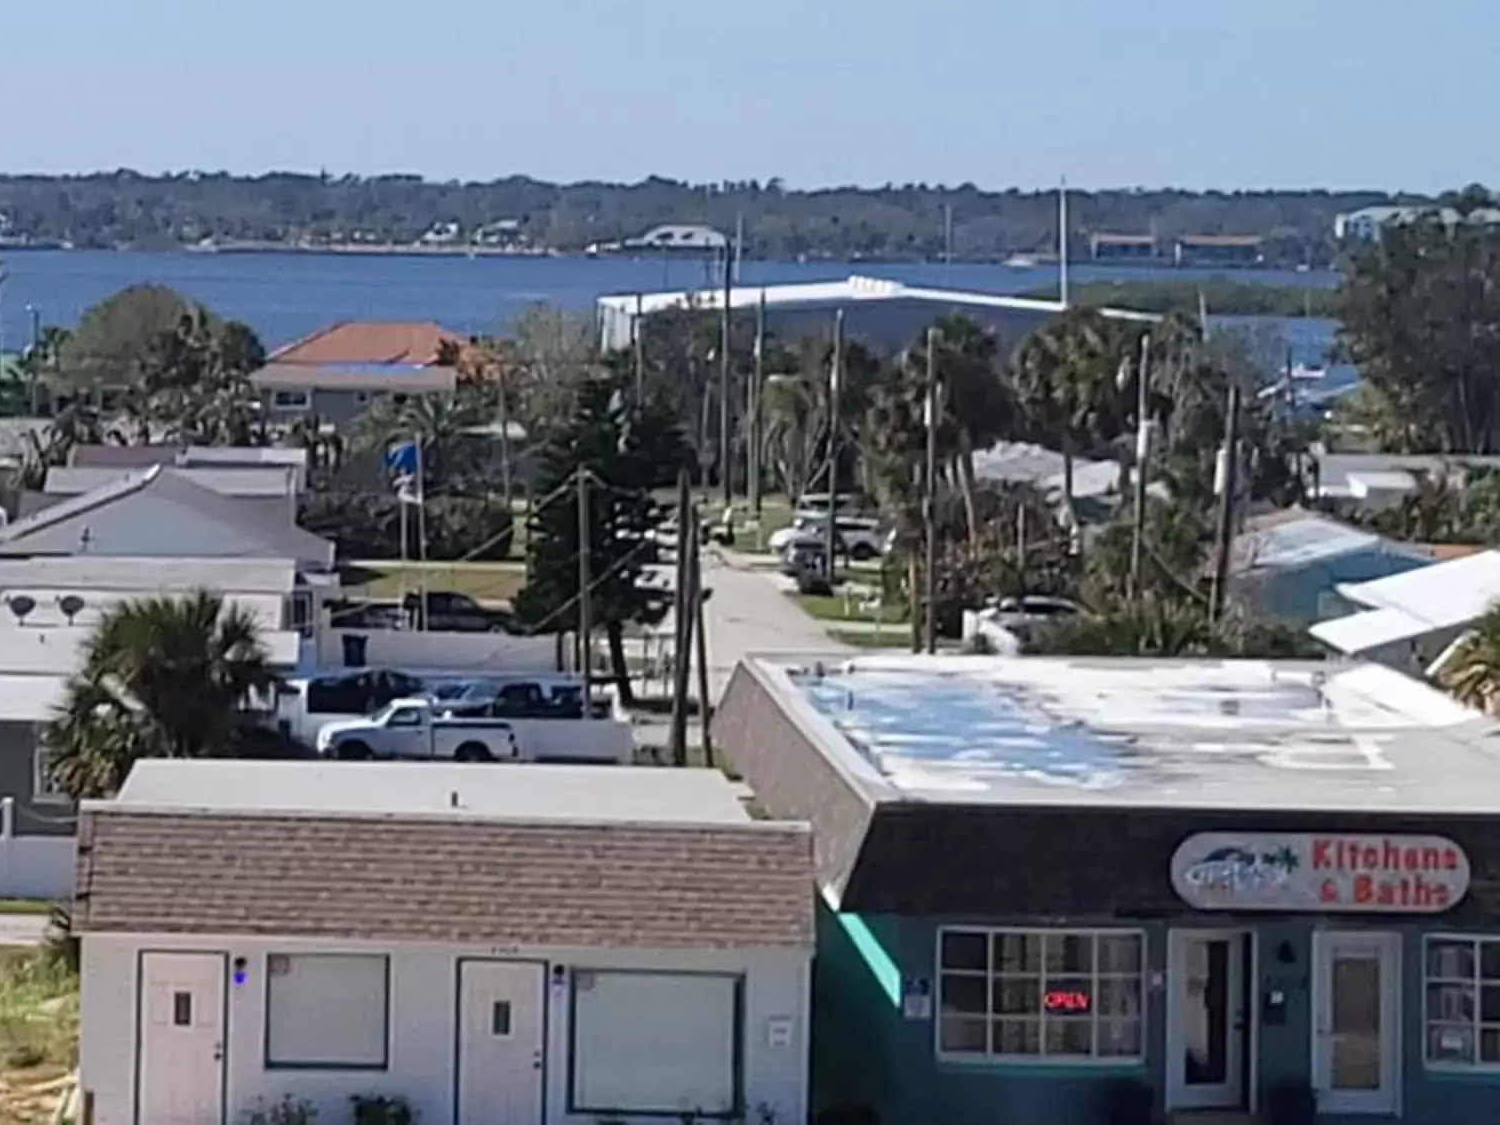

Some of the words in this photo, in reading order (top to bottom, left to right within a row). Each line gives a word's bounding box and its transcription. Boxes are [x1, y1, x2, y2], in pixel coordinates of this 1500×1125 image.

[1312, 838, 1458, 870] Kitchens
[1354, 874, 1449, 905] Baths
[1044, 990, 1088, 1008] OPEN
